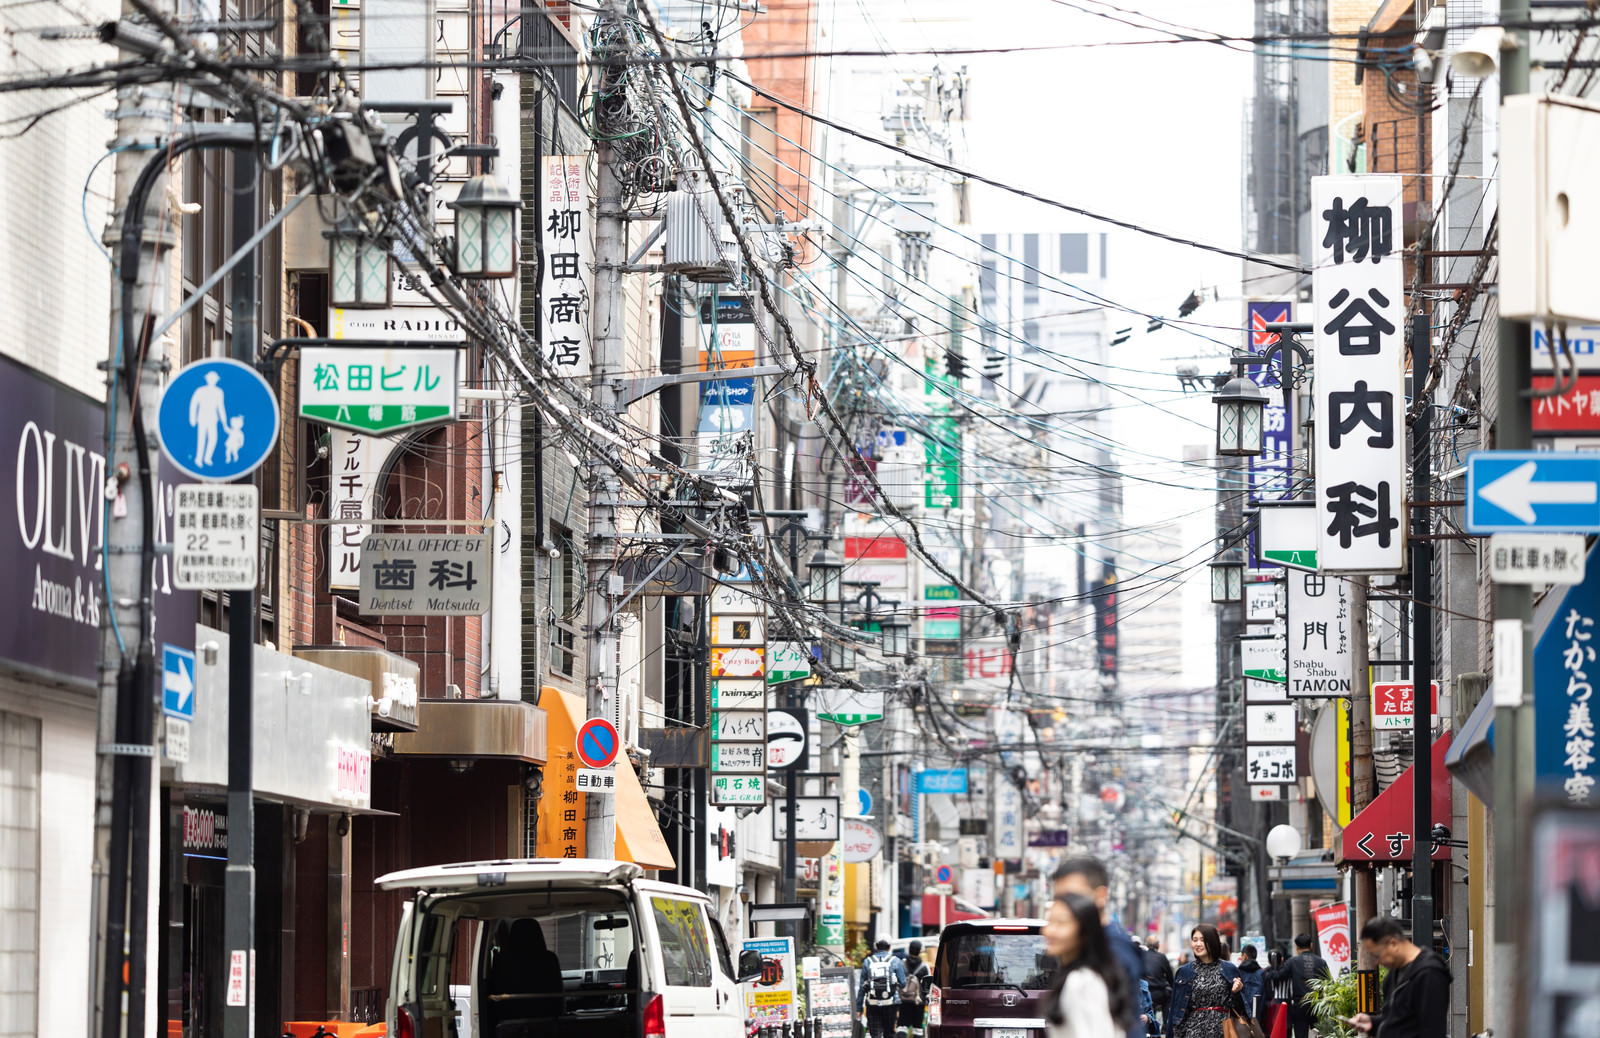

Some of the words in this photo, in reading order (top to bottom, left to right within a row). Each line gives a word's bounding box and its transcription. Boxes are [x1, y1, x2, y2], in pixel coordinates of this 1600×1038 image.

[546, 208, 582, 367] 柳田商店
[384, 319, 459, 331] RADIO
[312, 363, 441, 393] 松田ビル
[1322, 196, 1399, 550] 柳谷内科
[340, 432, 363, 573] プル千扇ビル
[187, 533, 208, 551] 22
[241, 535, 246, 551] 1
[366, 538, 415, 552] DENTAL
[418, 539, 463, 552] OFFICE
[465, 539, 485, 552] 5F
[372, 558, 478, 591] 歯科
[32, 563, 72, 619] Aroma
[74, 576, 85, 623] &
[85, 581, 102, 629] As
[369, 597, 415, 611] Dentist
[426, 597, 481, 611] Matsuda
[1336, 576, 1347, 655] しゃぶしゃぶ
[1293, 660, 1324, 669] Shabu
[1306, 668, 1337, 677] Shabu
[1293, 679, 1351, 692] TAMON
[1384, 687, 1413, 701] くす
[1383, 700, 1413, 713] たば
[1563, 608, 1597, 804] たから美容室
[1385, 716, 1412, 726] ハトヤ
[1250, 760, 1294, 780] チョコボ
[577, 773, 615, 789] 自動車
[716, 776, 761, 791] 明石焼
[562, 790, 578, 858] 柳田商店
